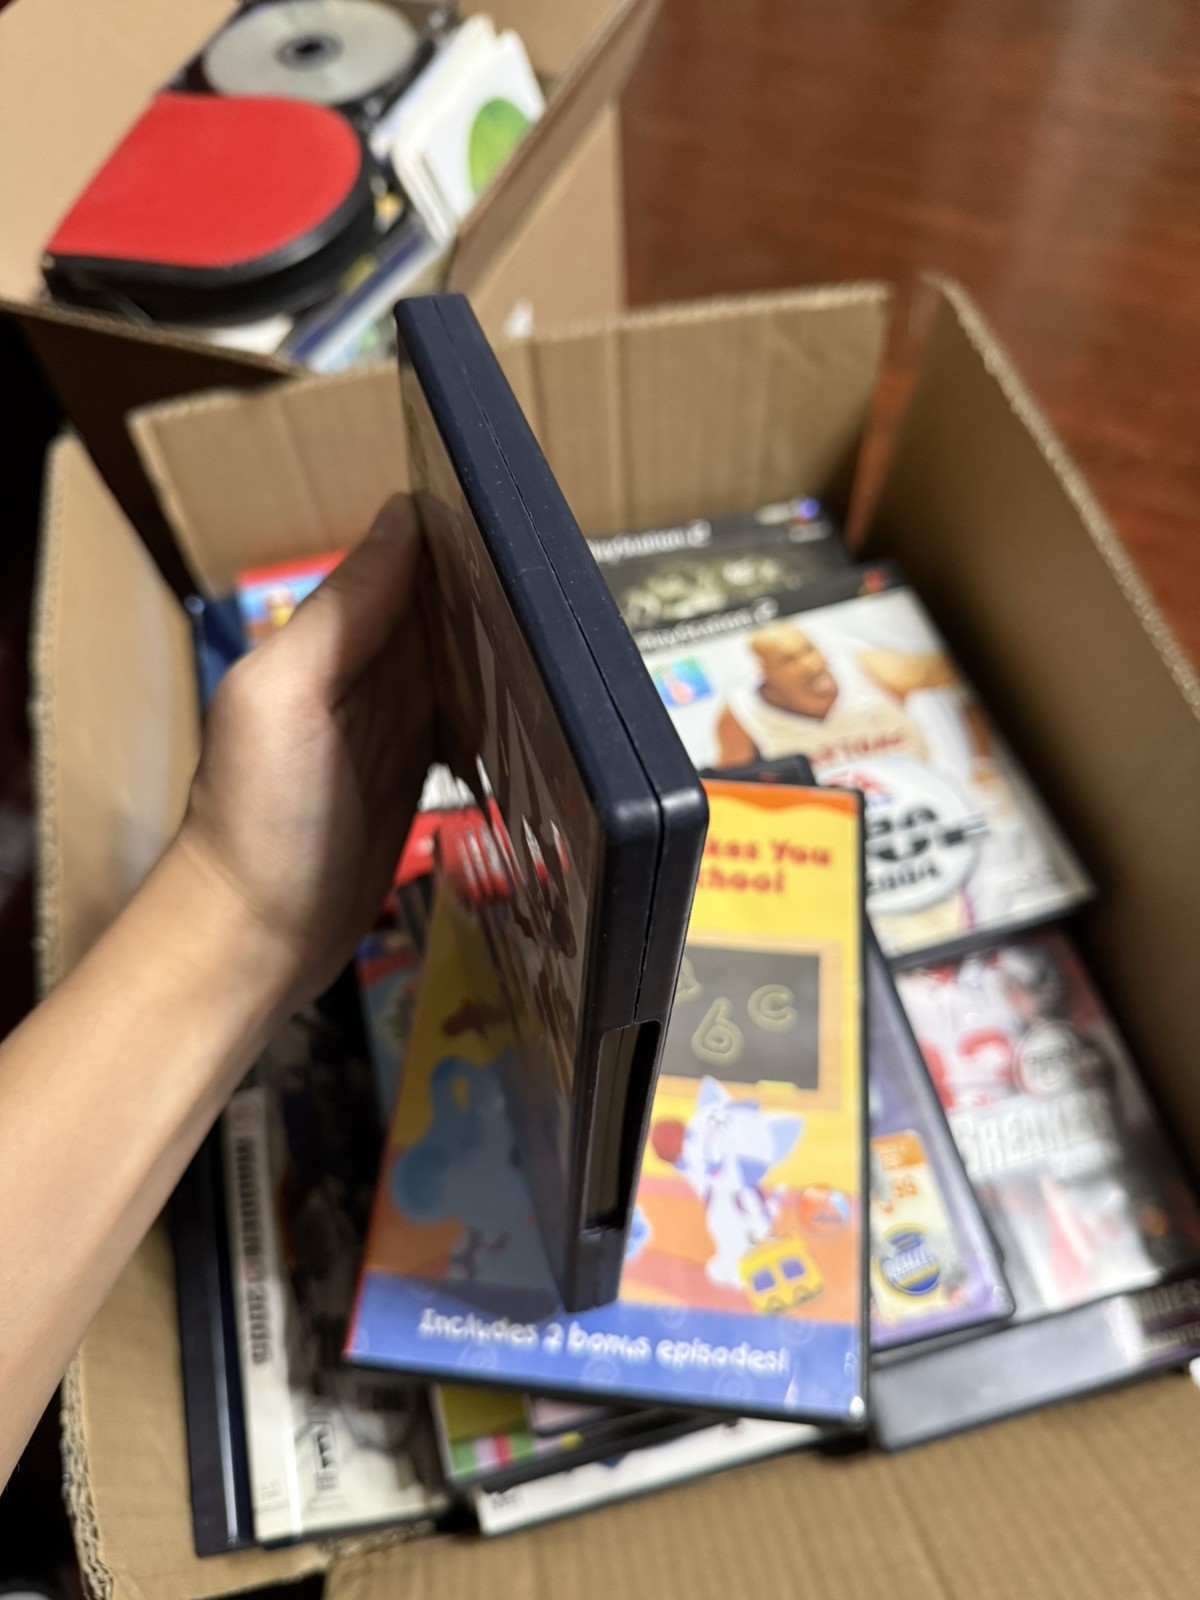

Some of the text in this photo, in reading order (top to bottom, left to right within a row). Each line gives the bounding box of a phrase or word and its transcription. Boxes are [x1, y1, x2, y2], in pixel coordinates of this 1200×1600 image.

[704, 838, 833, 868] kes You
[419, 1308, 790, 1374] Includes 2 bonus episodes!
